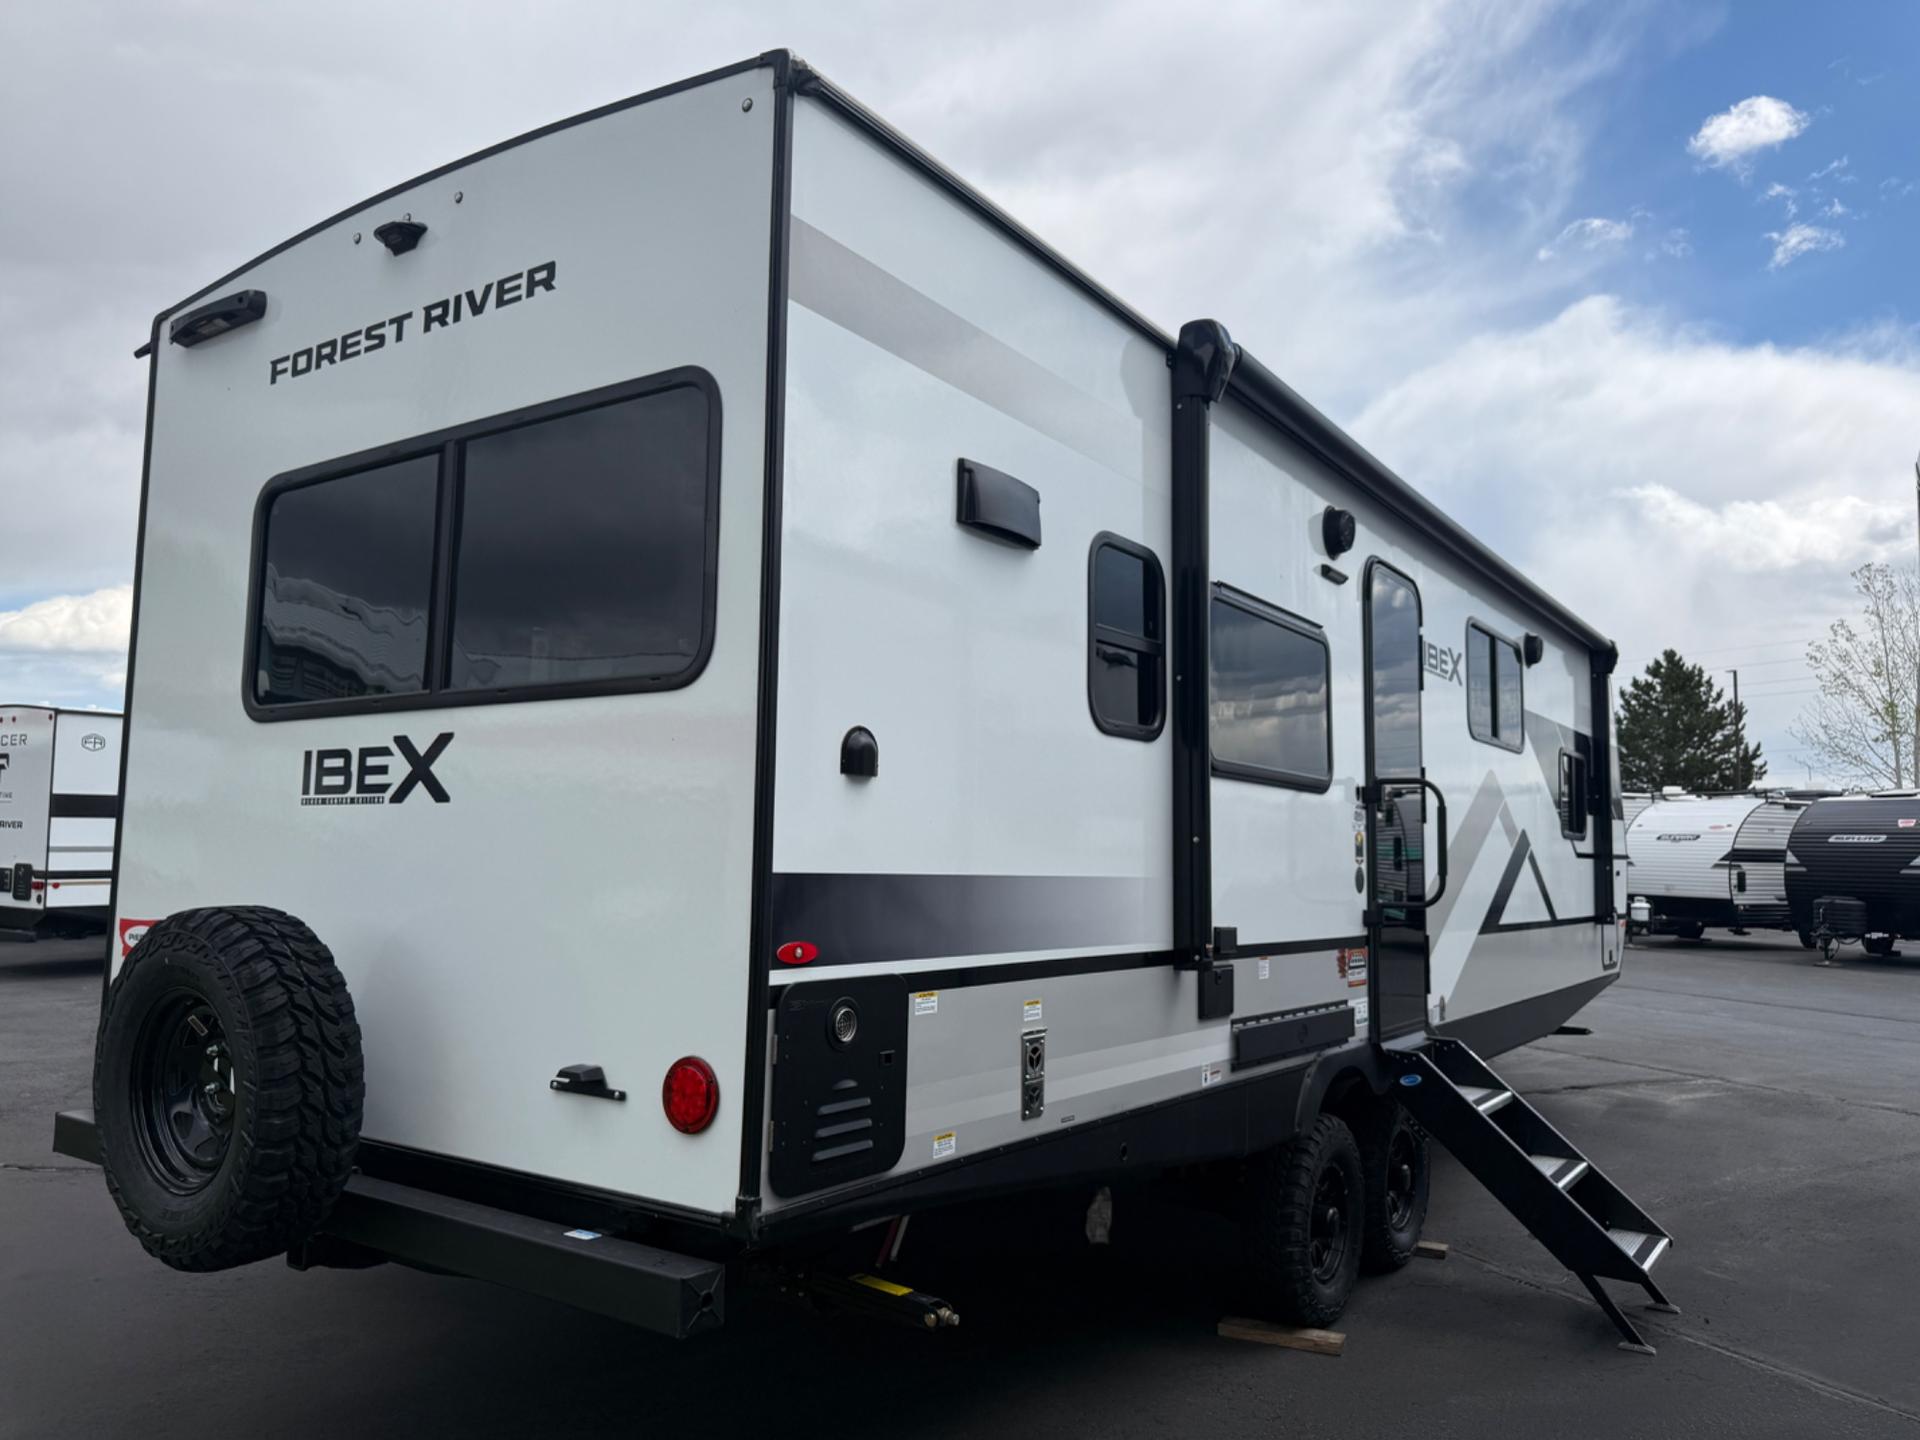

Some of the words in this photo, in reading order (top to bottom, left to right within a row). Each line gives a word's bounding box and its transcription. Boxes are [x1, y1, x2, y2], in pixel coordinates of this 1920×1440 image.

[270, 311, 413, 385] FOREST
[422, 260, 557, 334] RIVER
[1423, 640, 1463, 687] IBEX
[301, 731, 455, 804] IBEX
